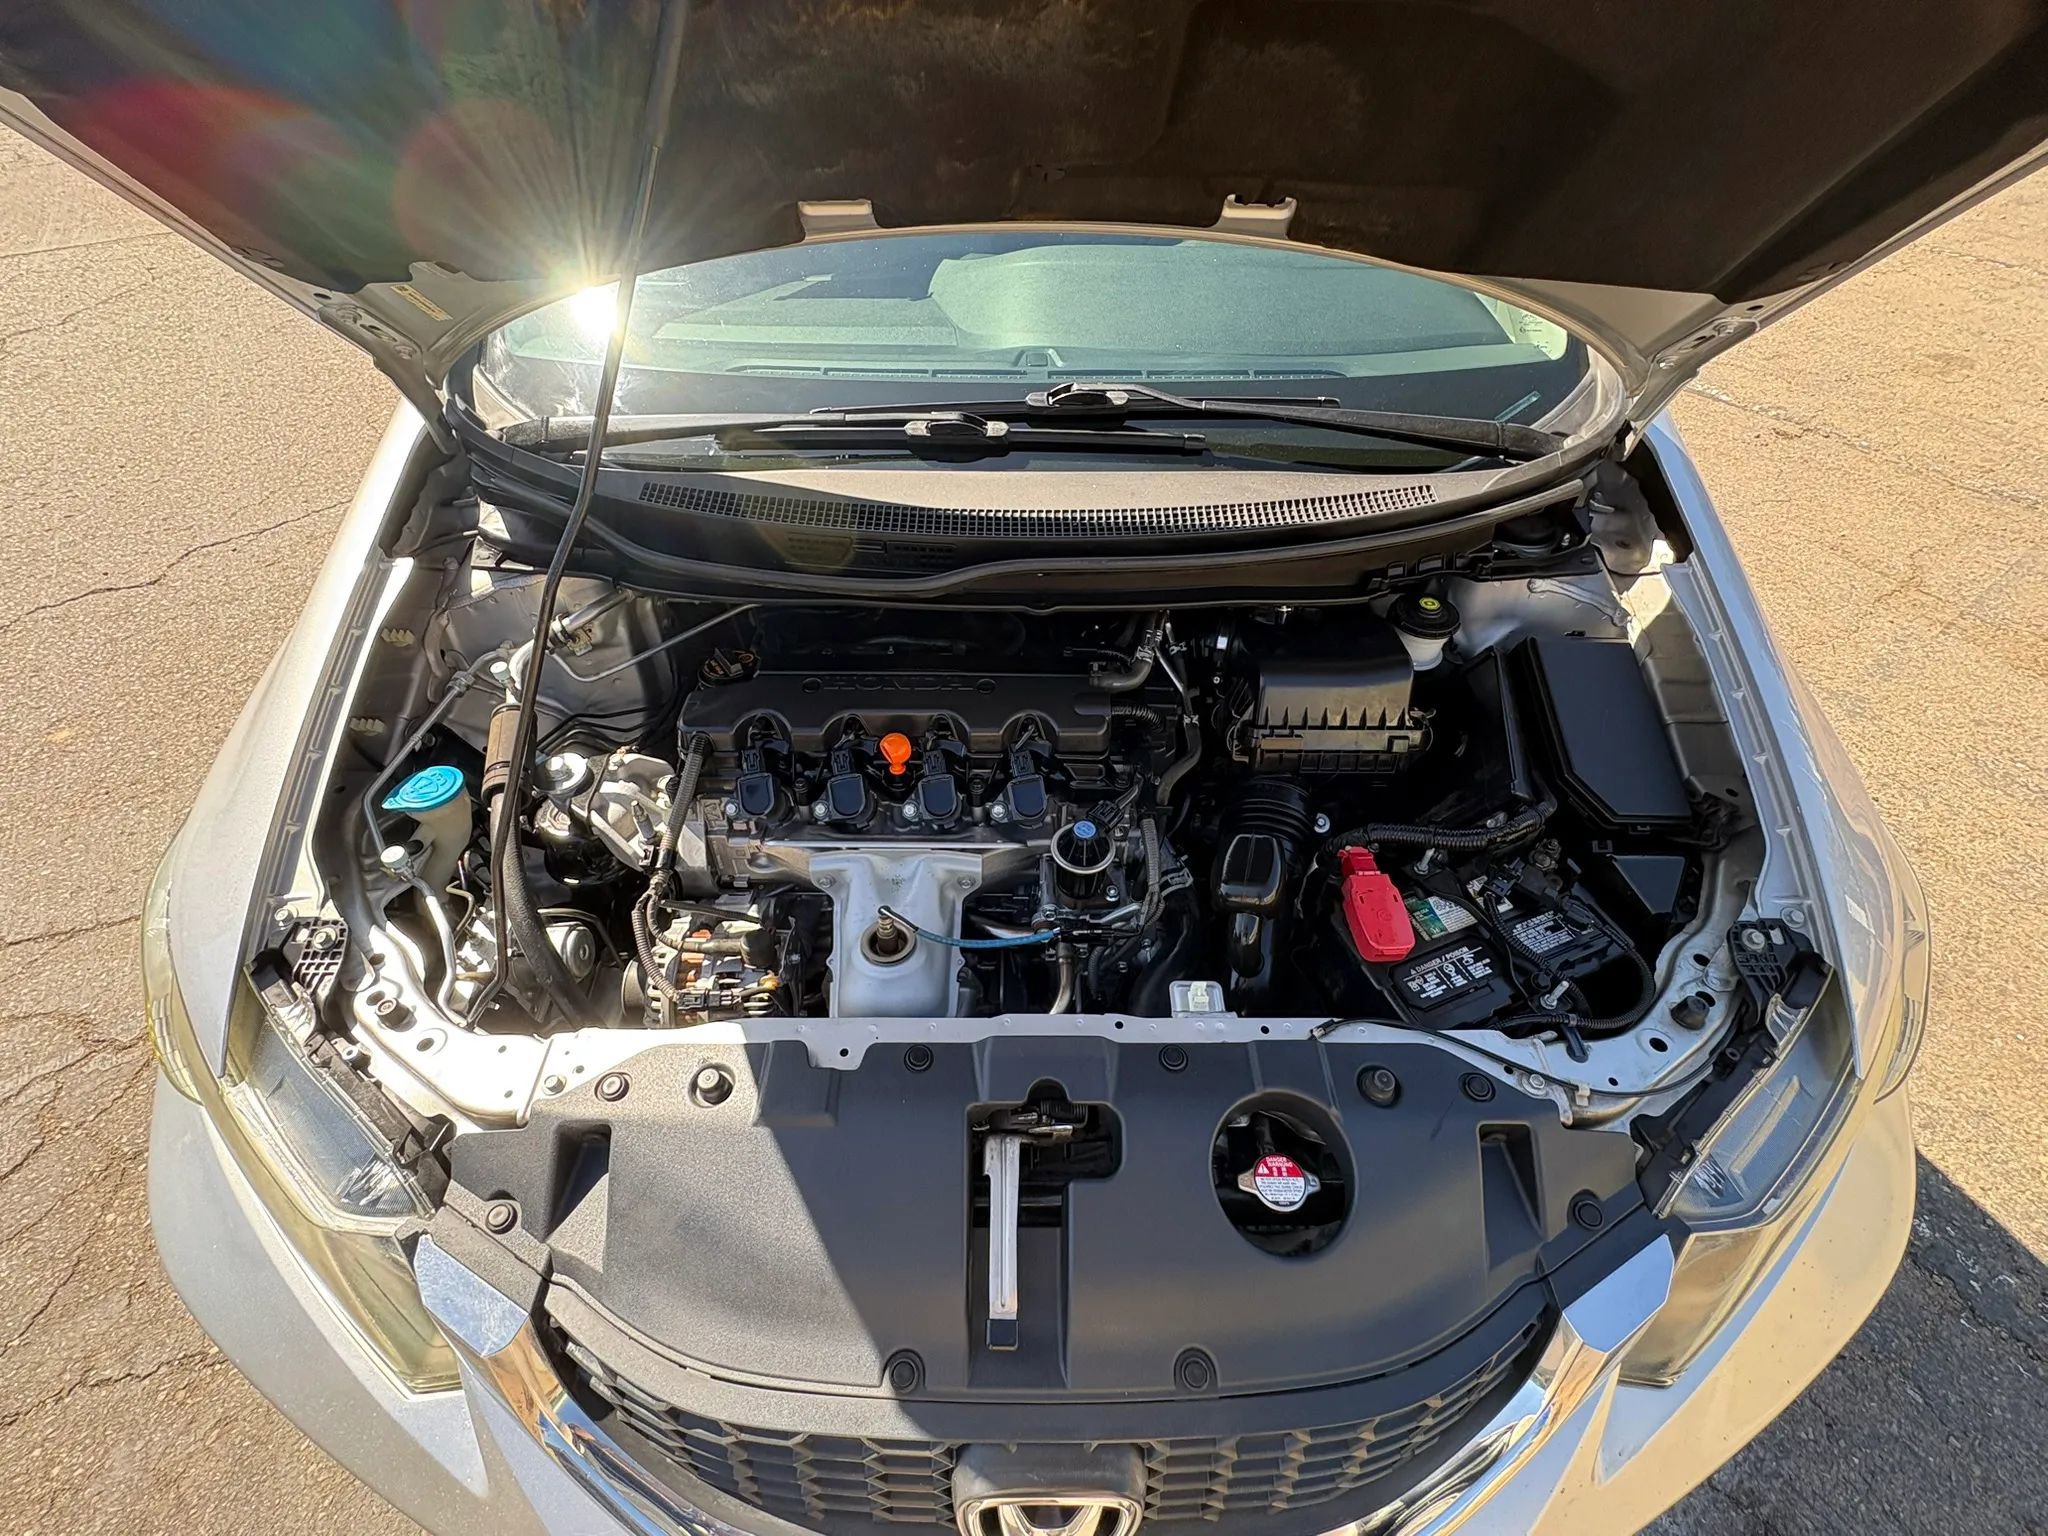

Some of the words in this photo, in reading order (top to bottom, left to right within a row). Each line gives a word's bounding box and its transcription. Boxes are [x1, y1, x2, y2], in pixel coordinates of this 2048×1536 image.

[823, 676, 974, 691] HONDA
[1415, 957, 1442, 973] DANGER
[1445, 946, 1470, 960] POISON
